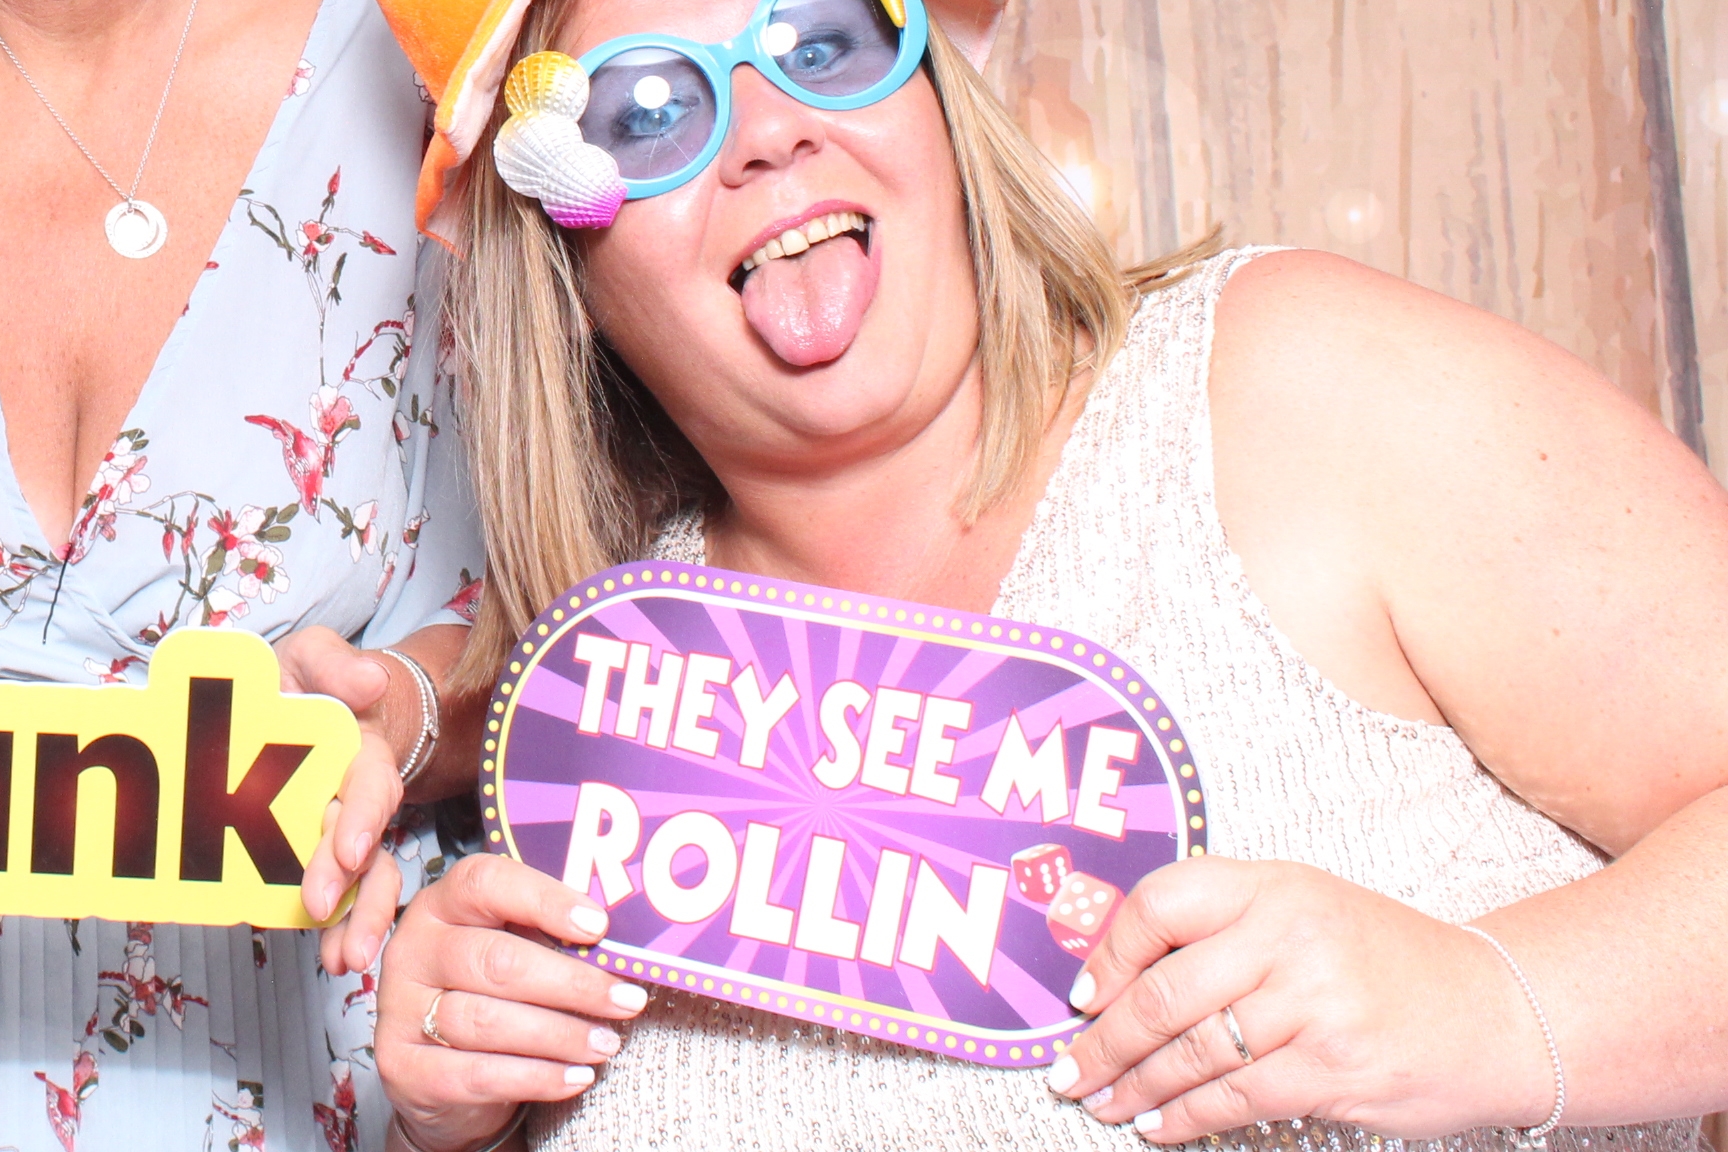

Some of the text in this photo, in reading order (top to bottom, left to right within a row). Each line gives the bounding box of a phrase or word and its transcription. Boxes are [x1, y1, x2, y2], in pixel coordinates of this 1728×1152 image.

[573, 633, 1141, 841] THEY SEE ME
[563, 780, 1010, 988] ROLLIN
